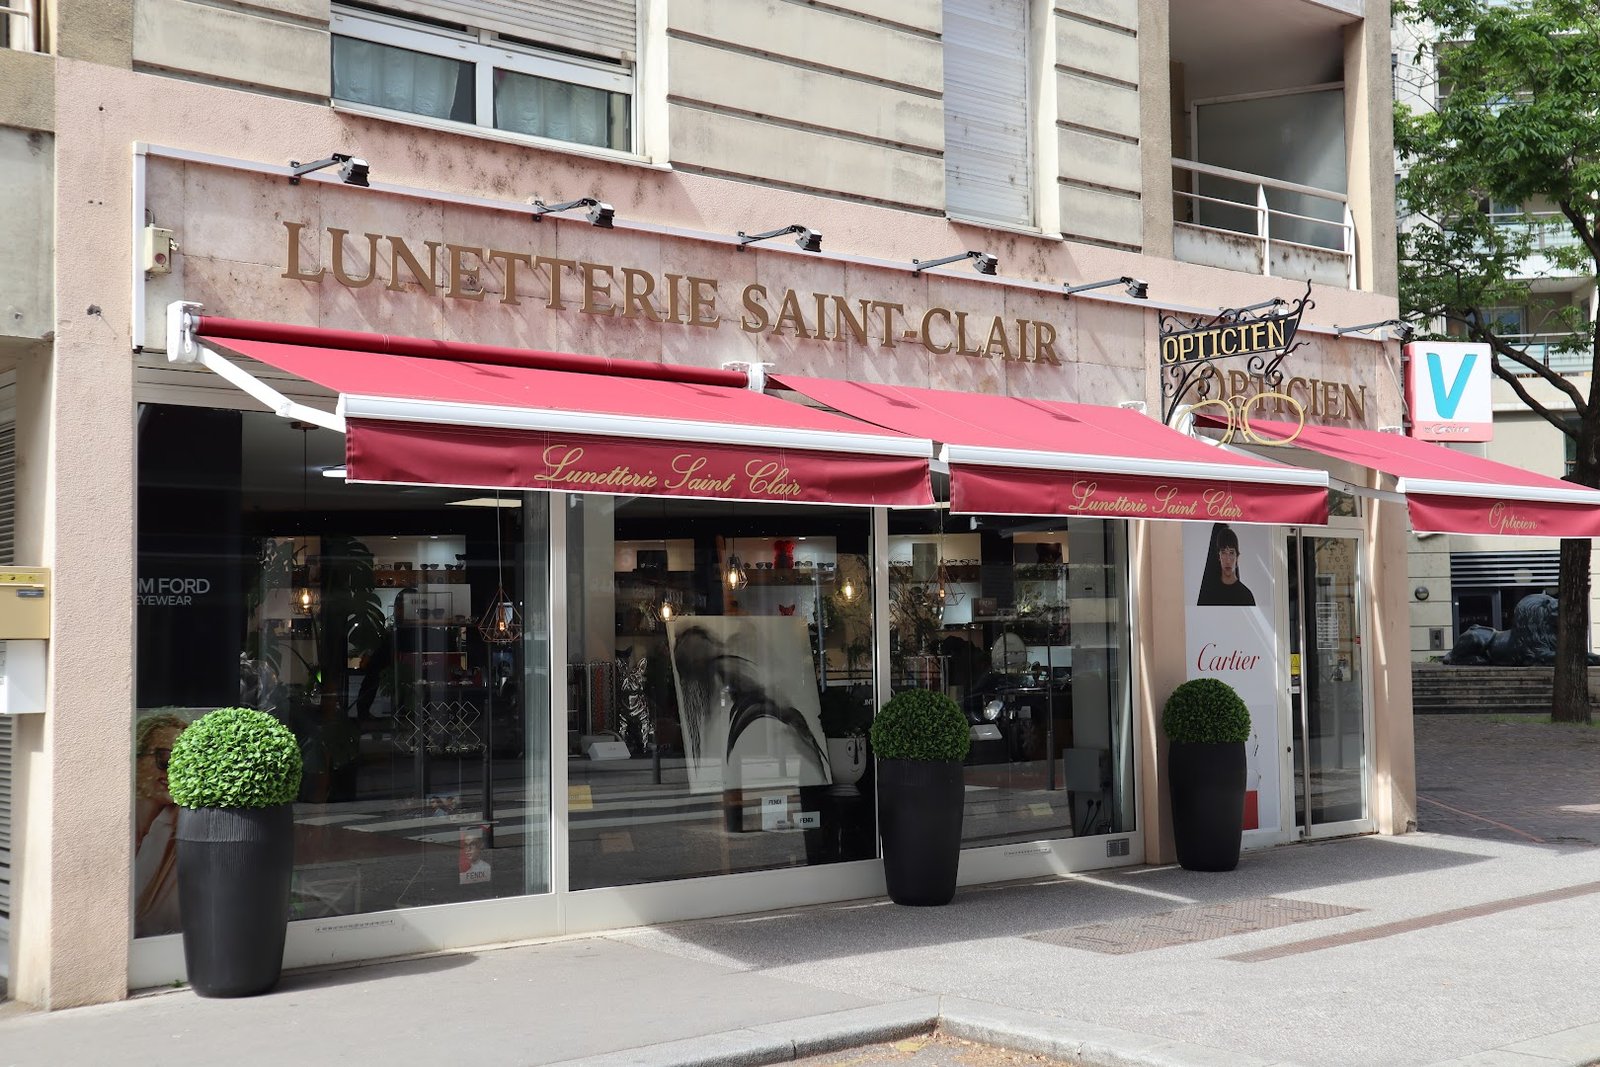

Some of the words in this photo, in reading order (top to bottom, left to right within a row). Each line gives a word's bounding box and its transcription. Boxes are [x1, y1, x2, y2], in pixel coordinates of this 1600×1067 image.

[281, 221, 721, 328] LUNETTERIE
[740, 284, 1062, 366] SAINT-CLAIR
[1163, 319, 1286, 364] OPTICIEN
[1195, 366, 1367, 423] OPTICIEN
[1426, 352, 1478, 419] V
[534, 445, 658, 488] Lunetterie
[664, 454, 736, 491] Saint
[745, 459, 801, 496] Clair
[1068, 480, 1148, 513] Lunetterie
[1152, 485, 1198, 515] Saint
[1203, 488, 1243, 518] Clair
[1488, 502, 1538, 535] Opticien
[158, 578, 211, 594] FORD
[1197, 643, 1260, 672] Cartier
